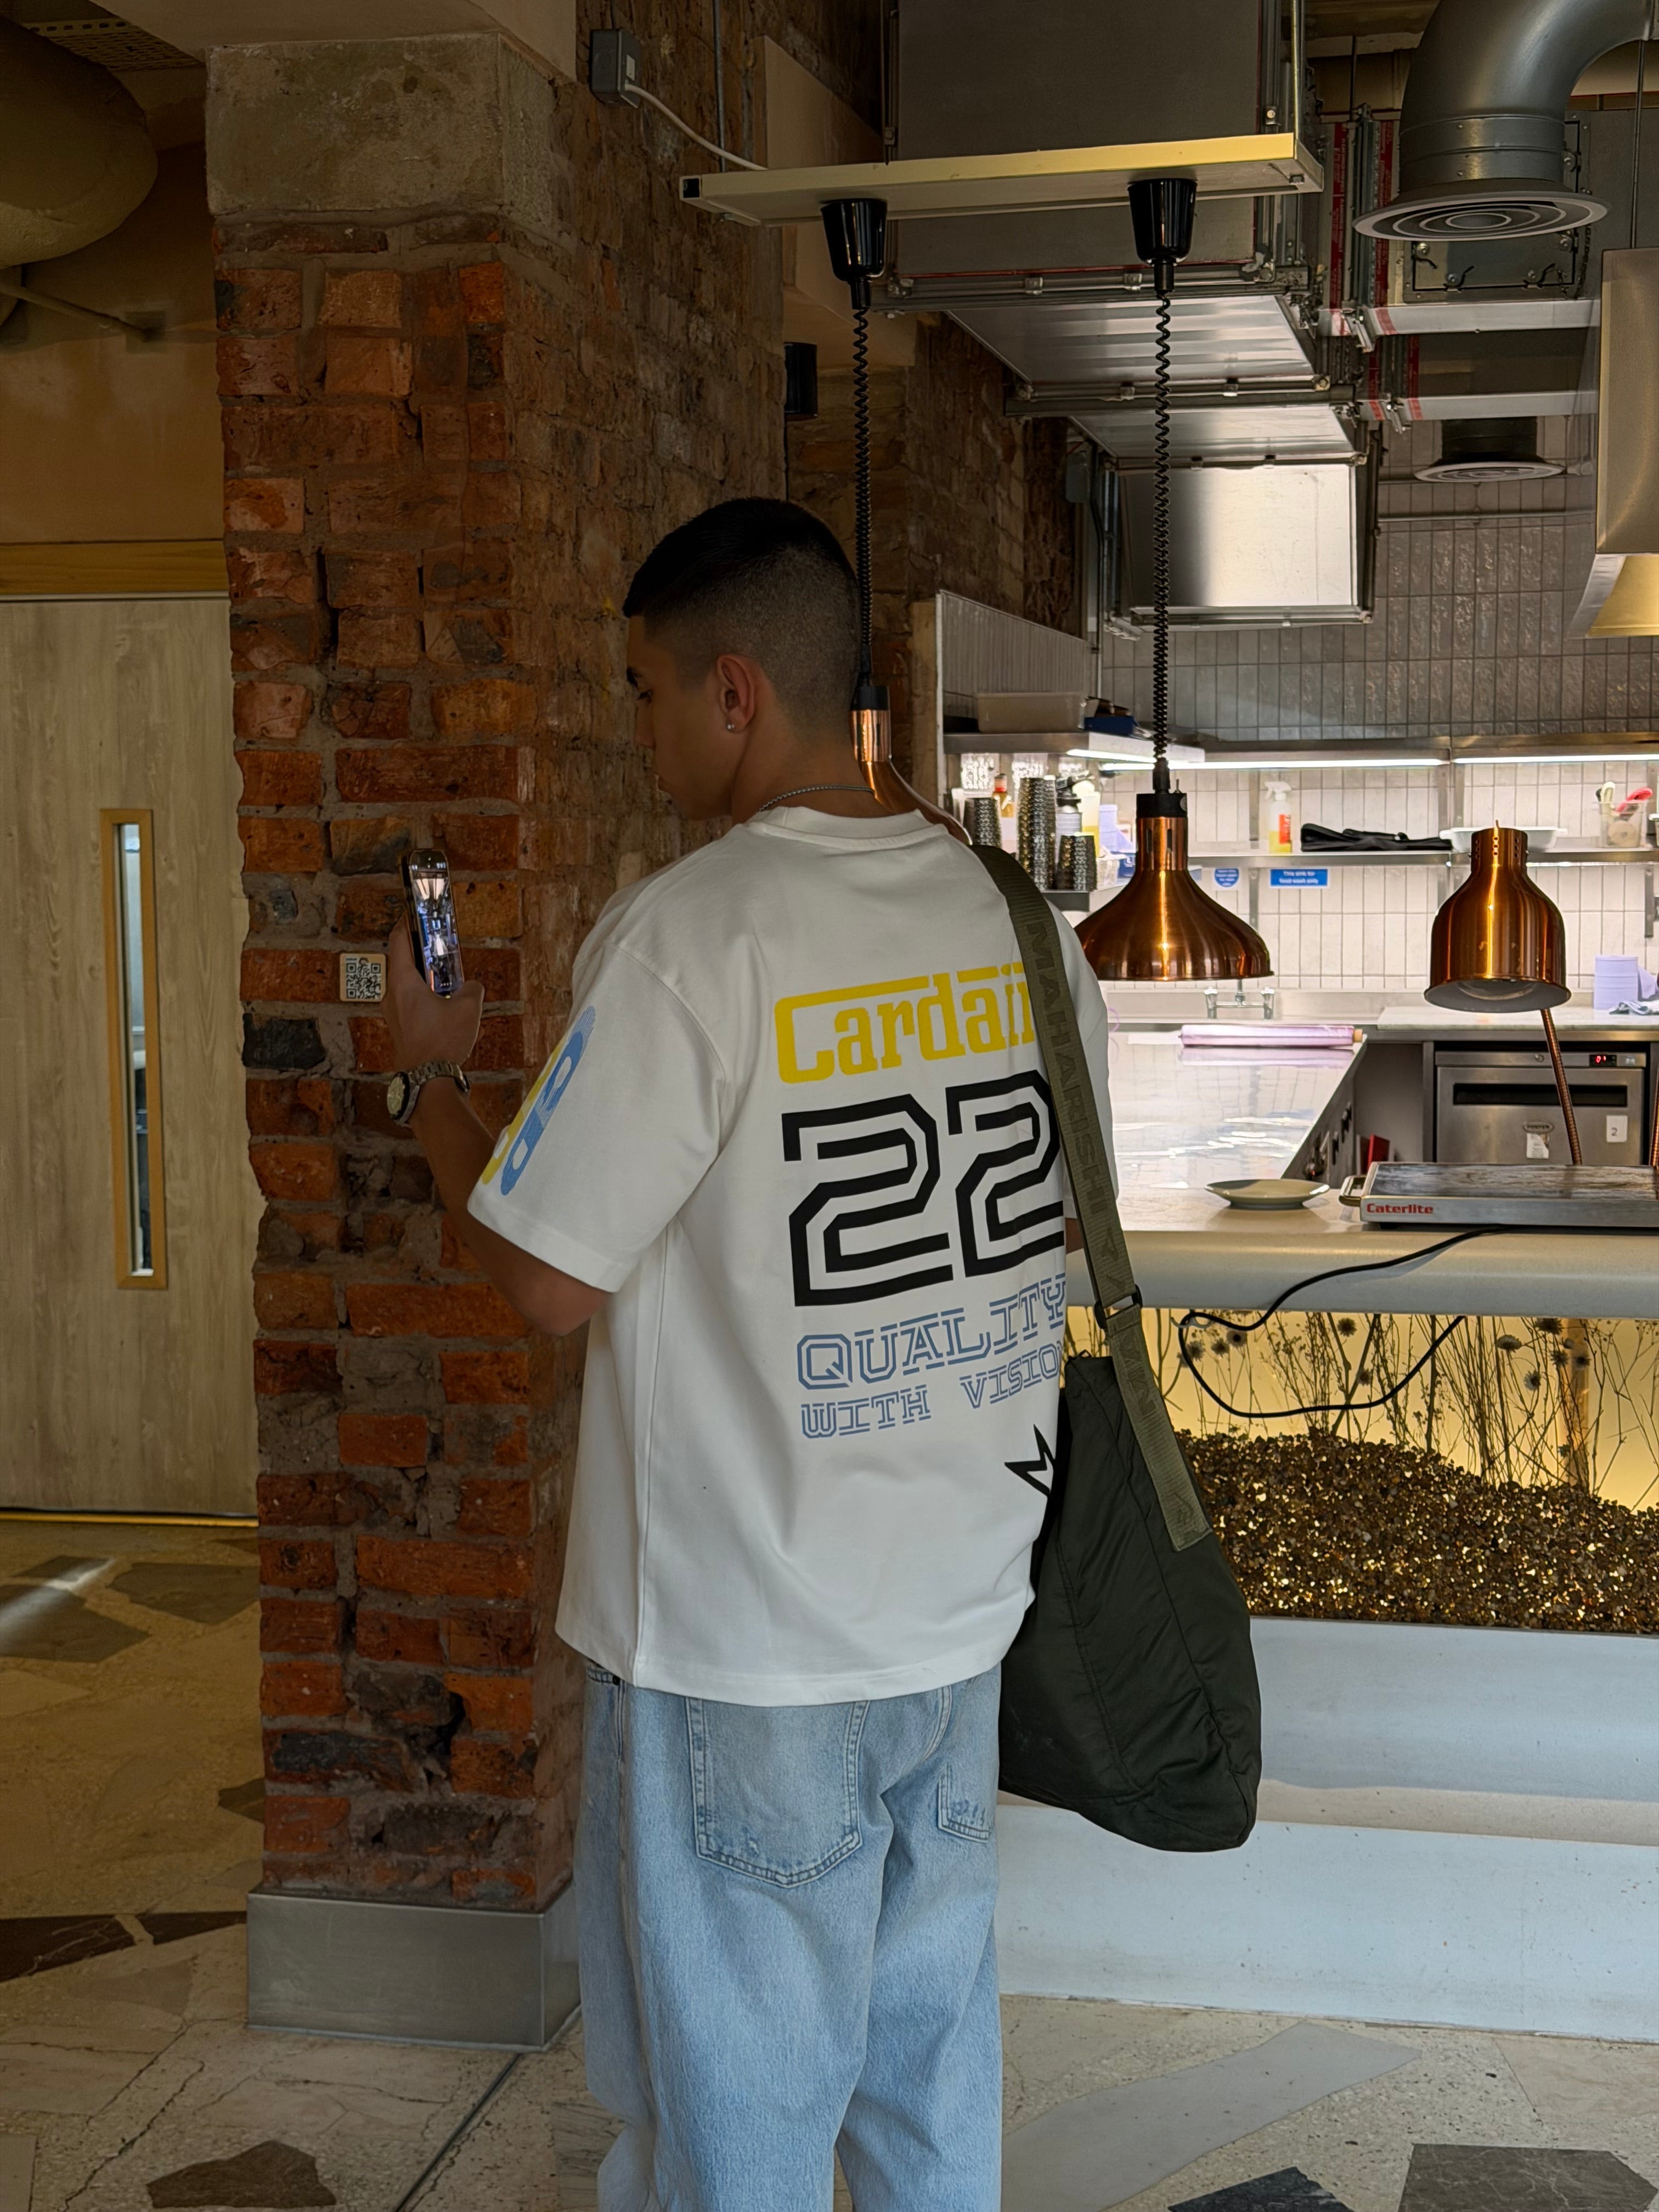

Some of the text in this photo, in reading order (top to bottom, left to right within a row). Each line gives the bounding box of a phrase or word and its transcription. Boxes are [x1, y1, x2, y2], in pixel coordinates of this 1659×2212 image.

[1611, 1127, 1618, 1137] 2
[781, 1069, 1065, 1307] 22
[1366, 1203, 1434, 1214] Caterlite
[797, 1272, 1066, 1390] QUALITY
[801, 1384, 931, 1439] WITH
